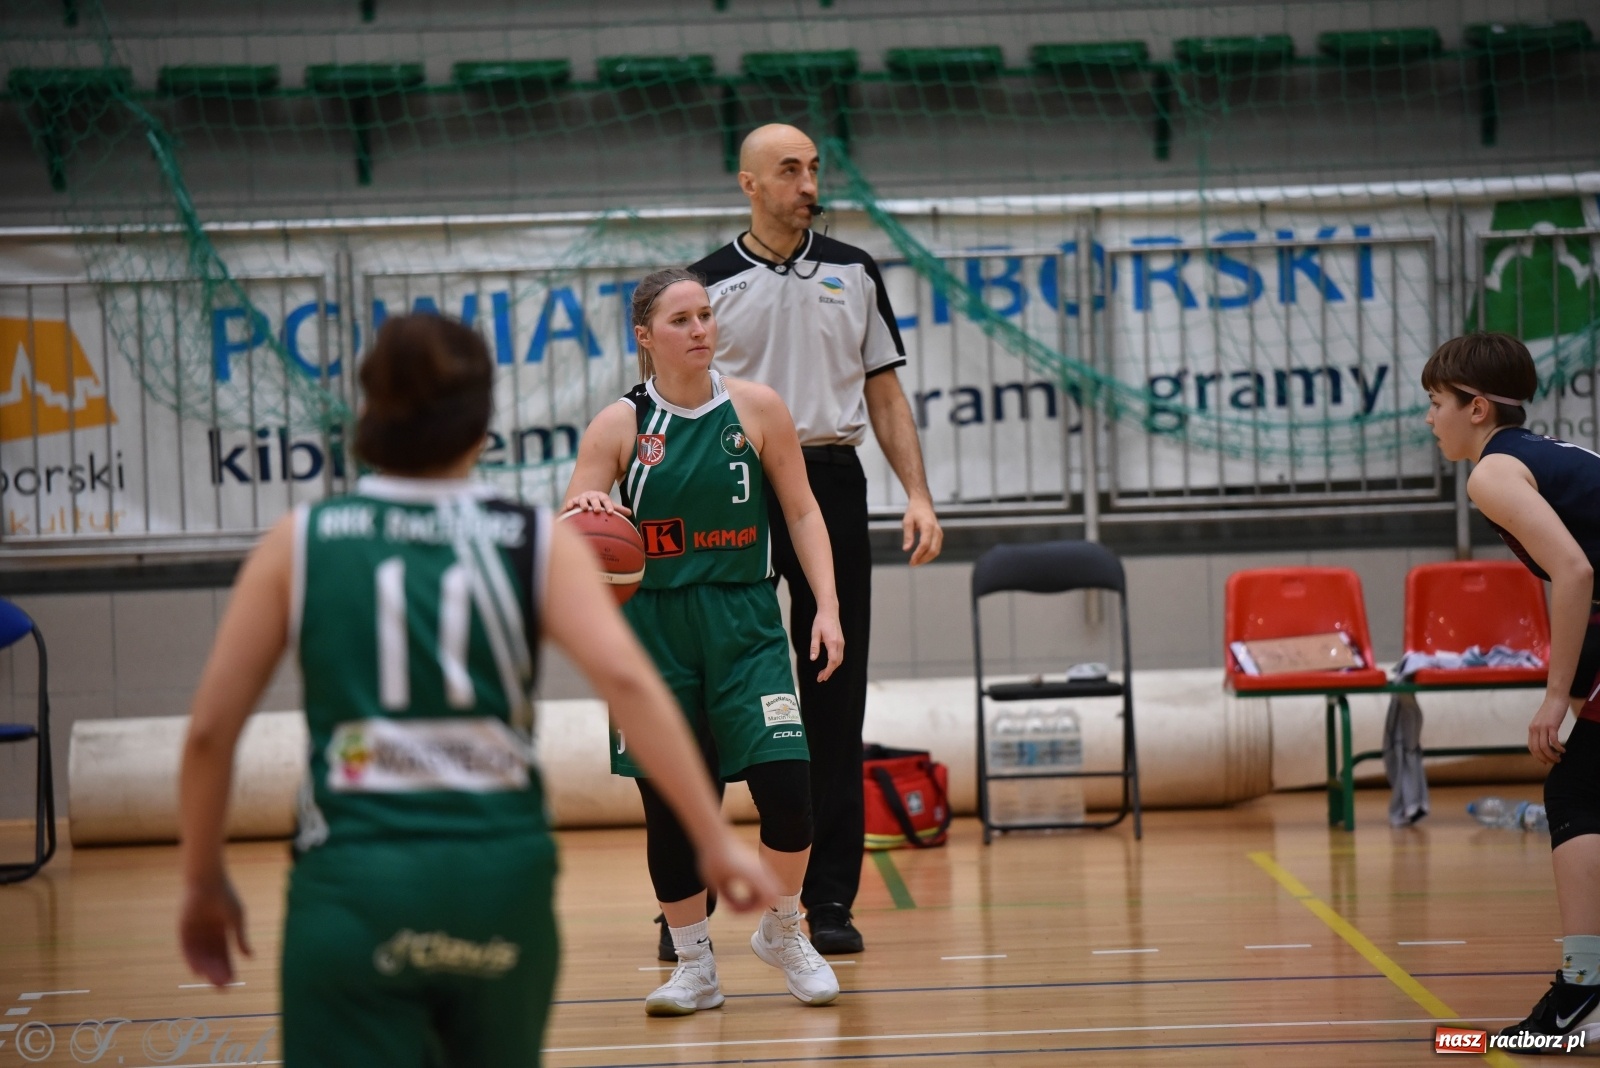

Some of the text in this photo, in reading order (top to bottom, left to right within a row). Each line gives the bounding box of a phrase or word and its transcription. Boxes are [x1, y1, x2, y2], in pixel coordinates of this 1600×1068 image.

[1147, 363, 1388, 434] gramy
[729, 461, 750, 504] 3
[643, 523, 757, 553] K KAMAN
